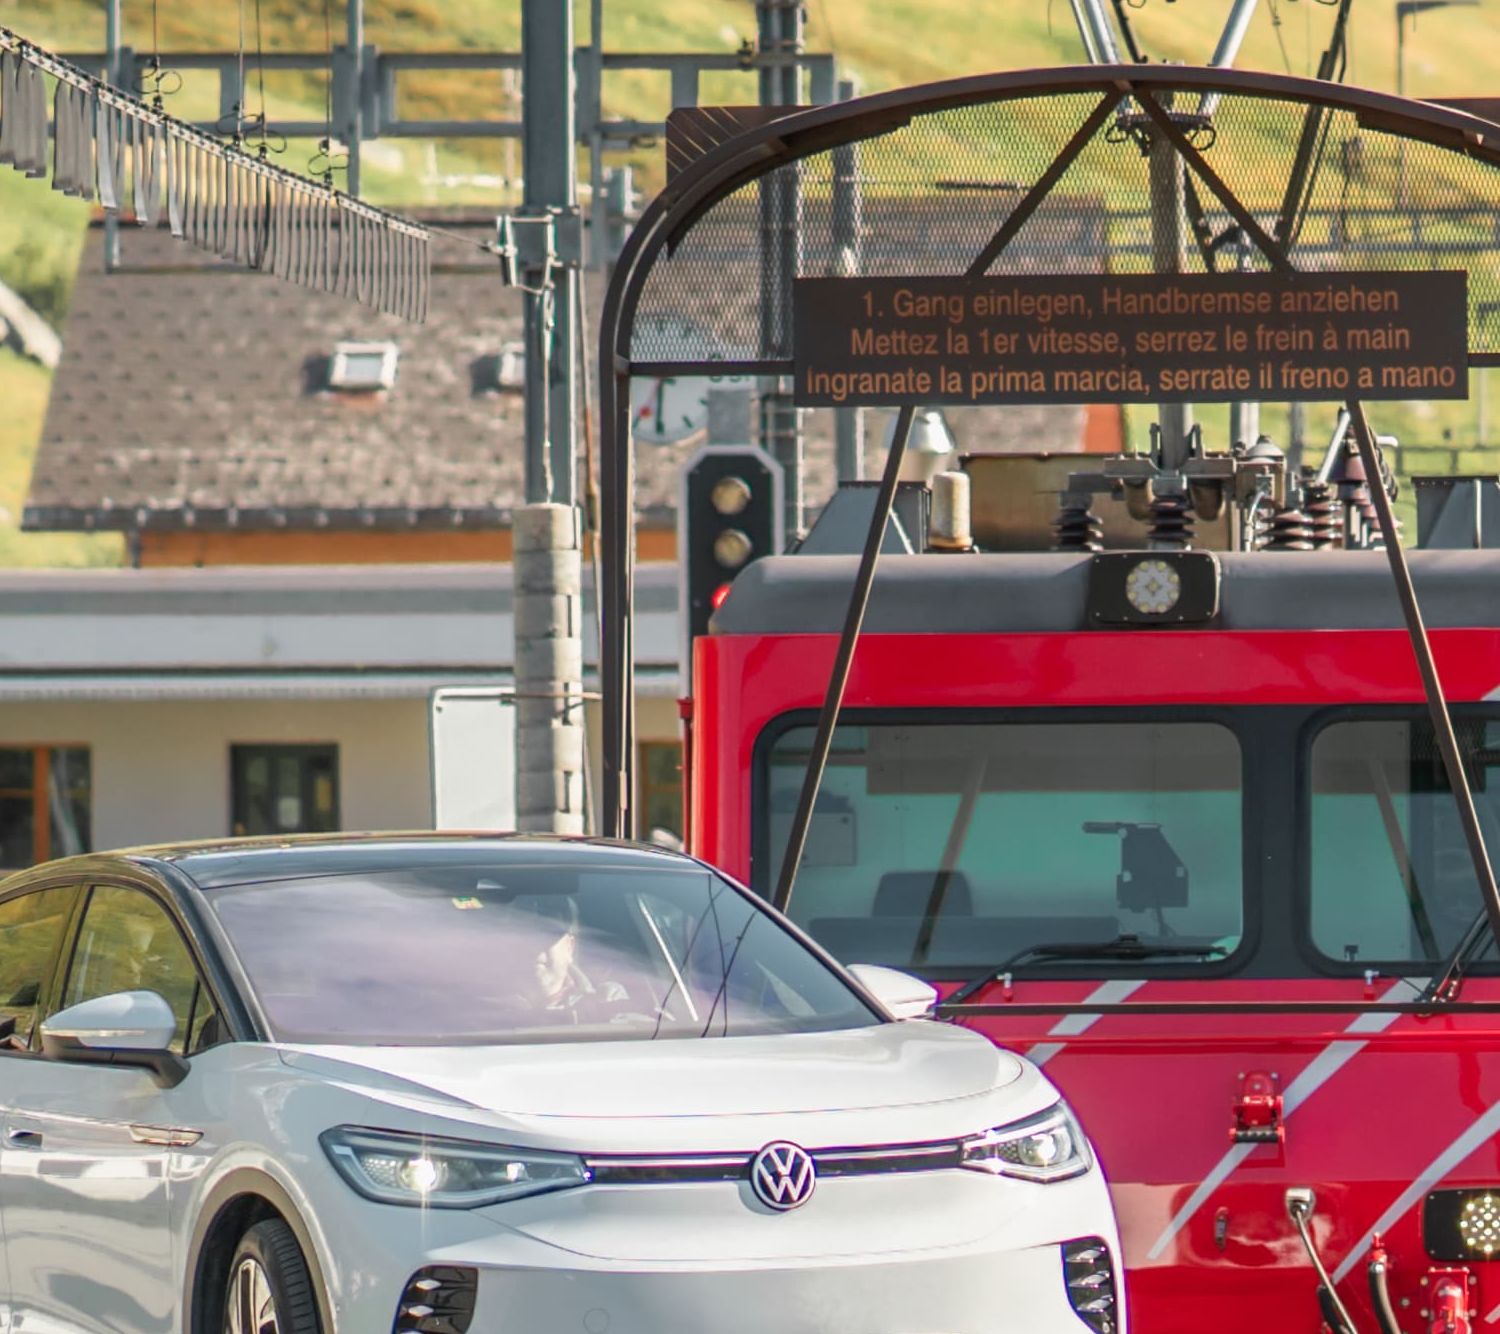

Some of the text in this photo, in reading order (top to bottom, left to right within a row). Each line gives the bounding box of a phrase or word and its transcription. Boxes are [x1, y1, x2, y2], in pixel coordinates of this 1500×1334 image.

[861, 284, 1399, 324] 1. Gang einlegen, Handbremse anziehen
[851, 321, 1411, 358] Mettez la 1er vitesse, serrez le frein à main
[806, 360, 1456, 402] Ingranate la prima marcia, serrate il freno a mano
